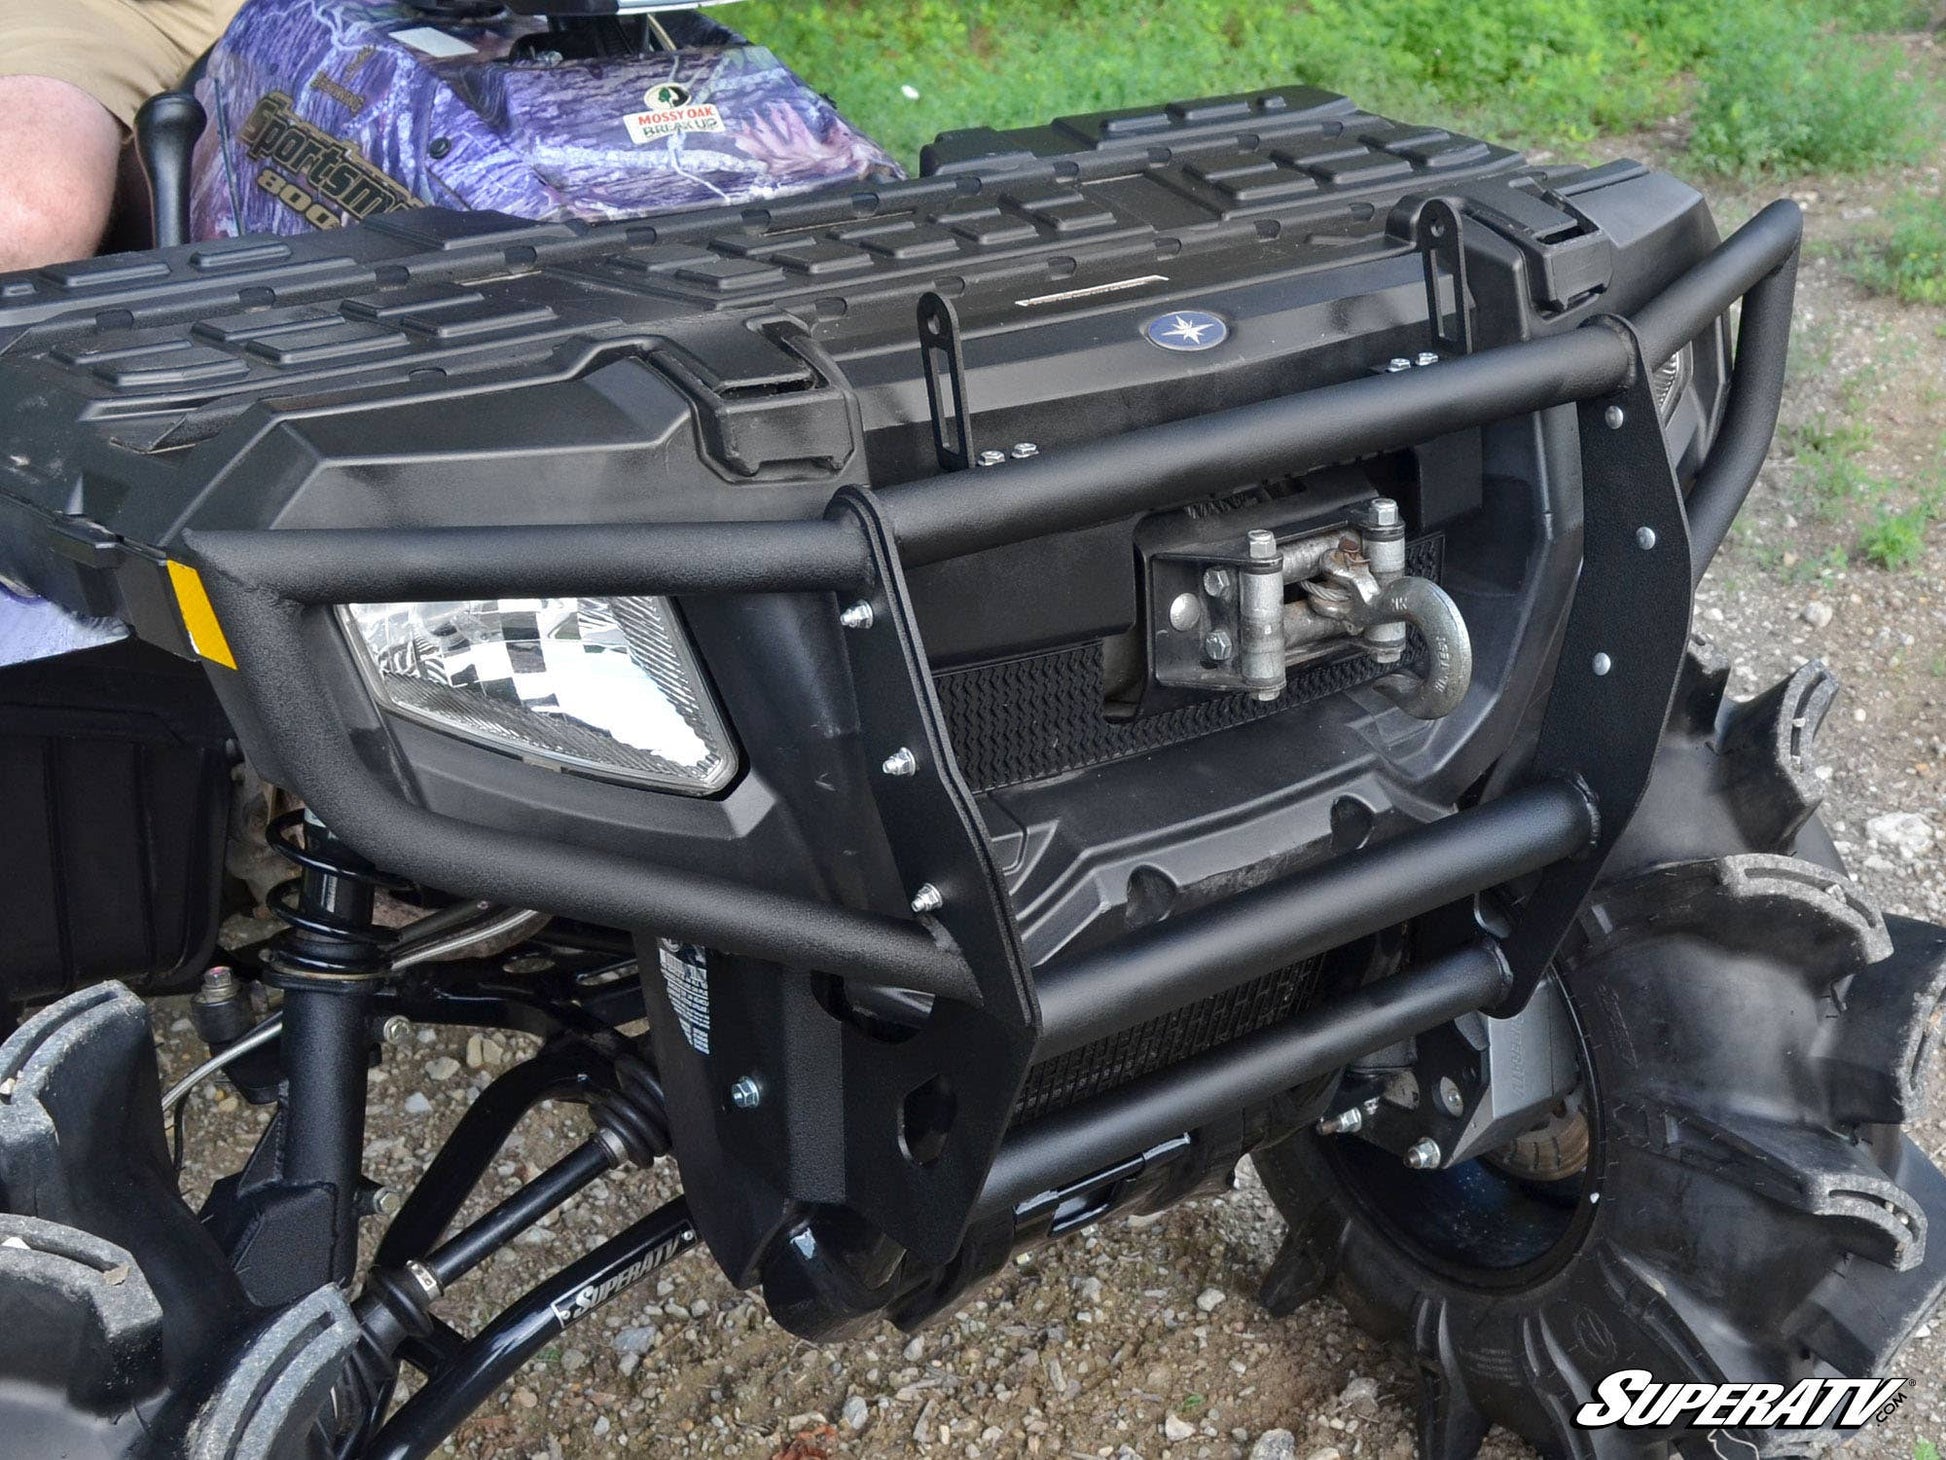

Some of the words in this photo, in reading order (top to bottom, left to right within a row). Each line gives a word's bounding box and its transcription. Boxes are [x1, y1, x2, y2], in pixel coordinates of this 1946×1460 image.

[638, 109, 684, 126] MOSSY
[687, 105, 713, 119] OAK
[239, 97, 409, 220] Sportsm
[257, 168, 341, 232] 800
[572, 1232, 681, 1319] SUPERATV
